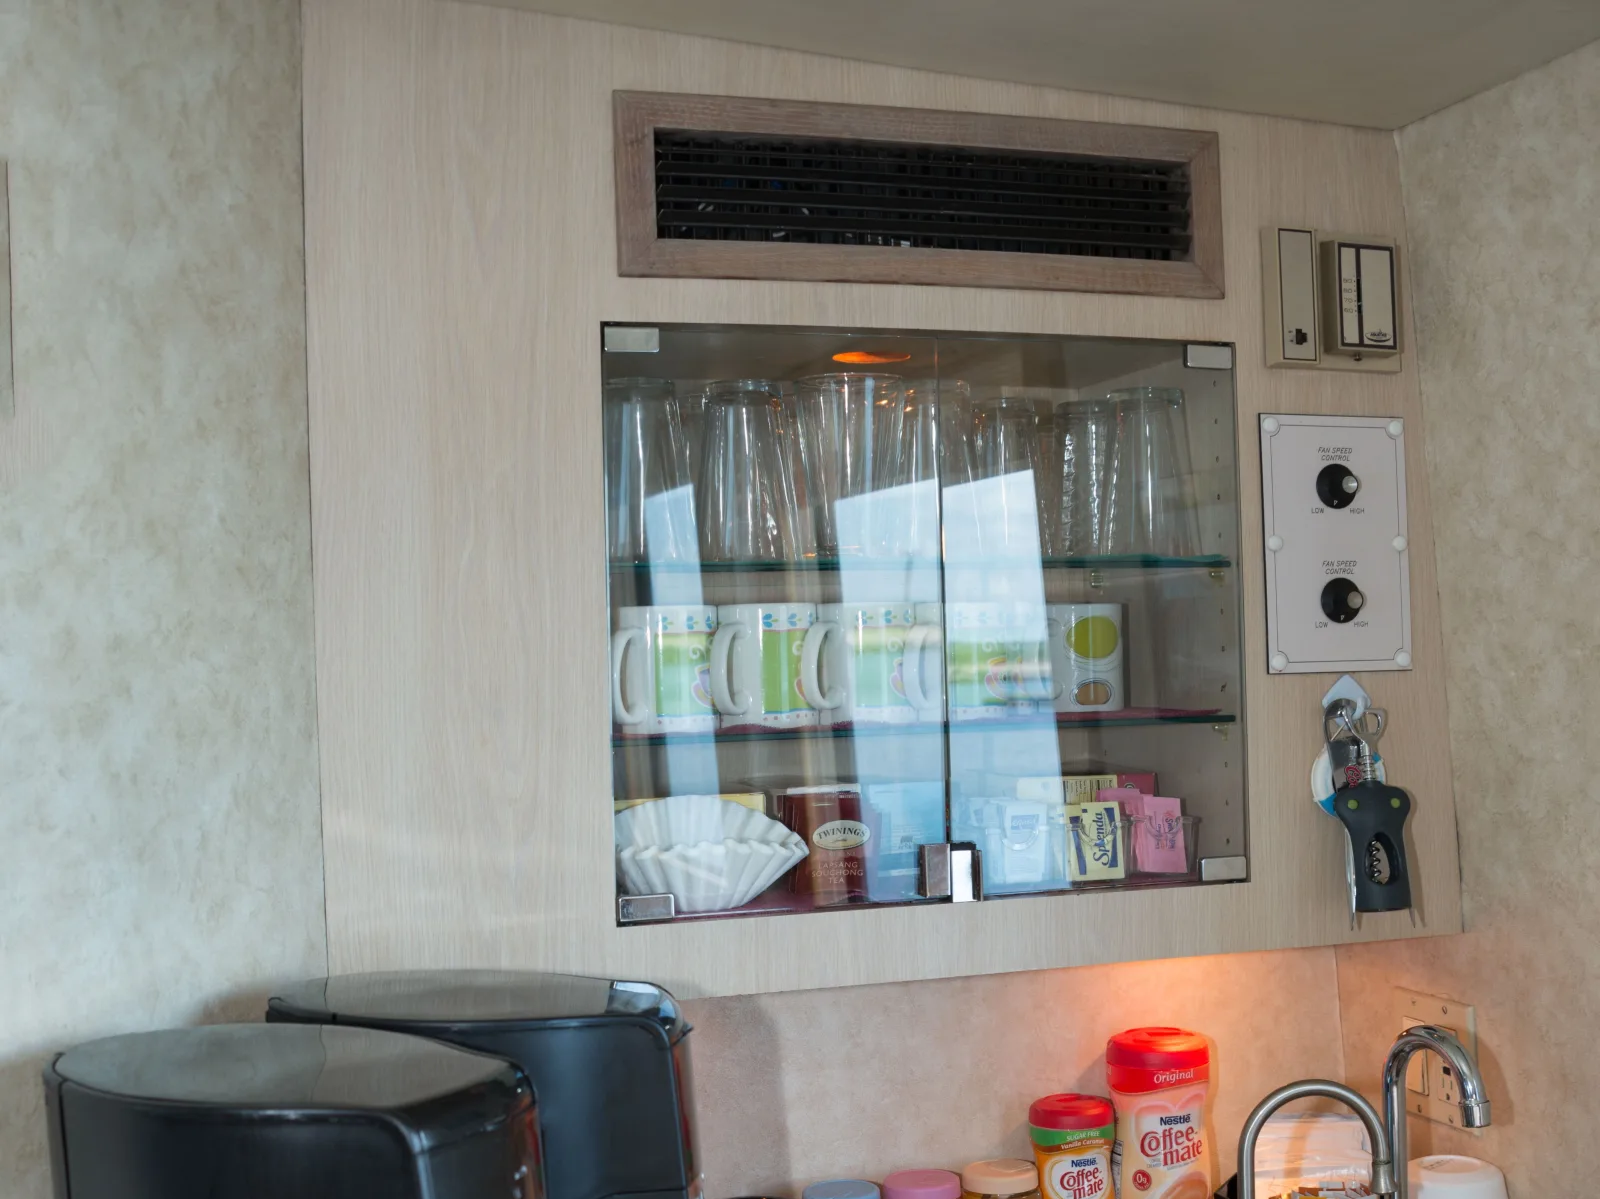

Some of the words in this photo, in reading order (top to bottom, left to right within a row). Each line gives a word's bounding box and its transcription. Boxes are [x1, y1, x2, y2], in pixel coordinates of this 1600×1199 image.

[816, 827, 867, 840] TWININGS
[812, 868, 864, 878] SOUCHONG
[1154, 1069, 1194, 1084] Original
[1066, 1132, 1086, 1141] SUGAR
[1060, 1140, 1081, 1149] Vanilla
[1162, 1139, 1203, 1166] mate
[1072, 1179, 1104, 1199] mate
